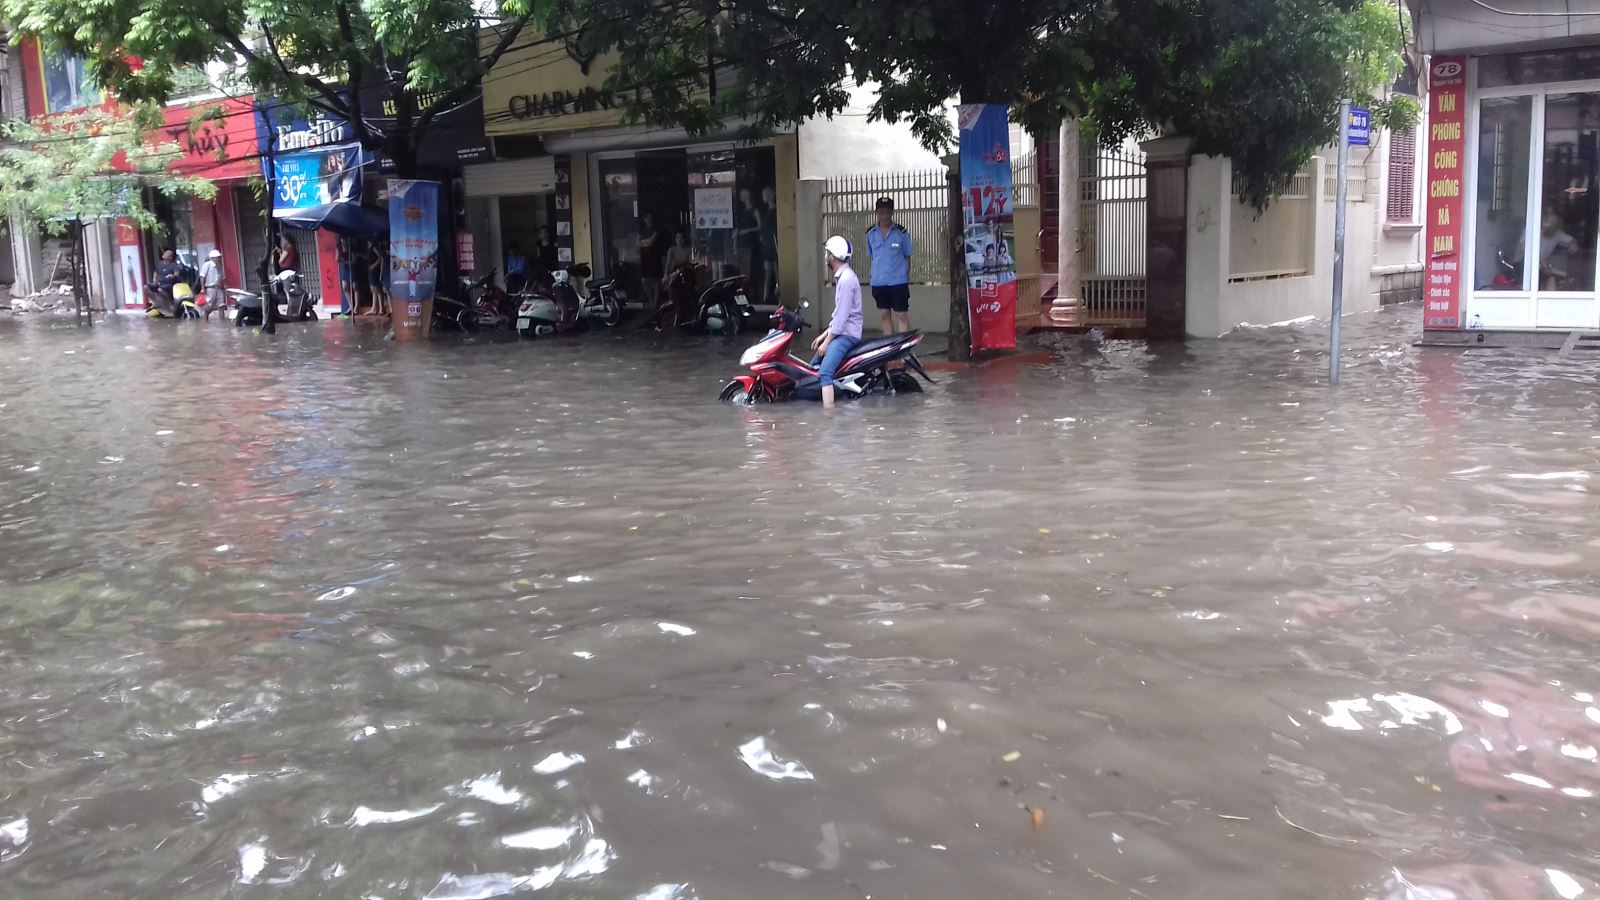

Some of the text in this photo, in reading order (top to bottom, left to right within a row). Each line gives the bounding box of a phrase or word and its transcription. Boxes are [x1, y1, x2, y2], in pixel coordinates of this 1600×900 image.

[1437, 64, 1458, 75] 78
[1438, 91, 1456, 113] VĂN
[1432, 118, 1461, 142] PHÒNG
[1434, 147, 1457, 170] CÔNG
[1431, 174, 1459, 198] CHỨNG
[1438, 204, 1450, 226] HÀ
[1433, 235, 1454, 253] NAM
